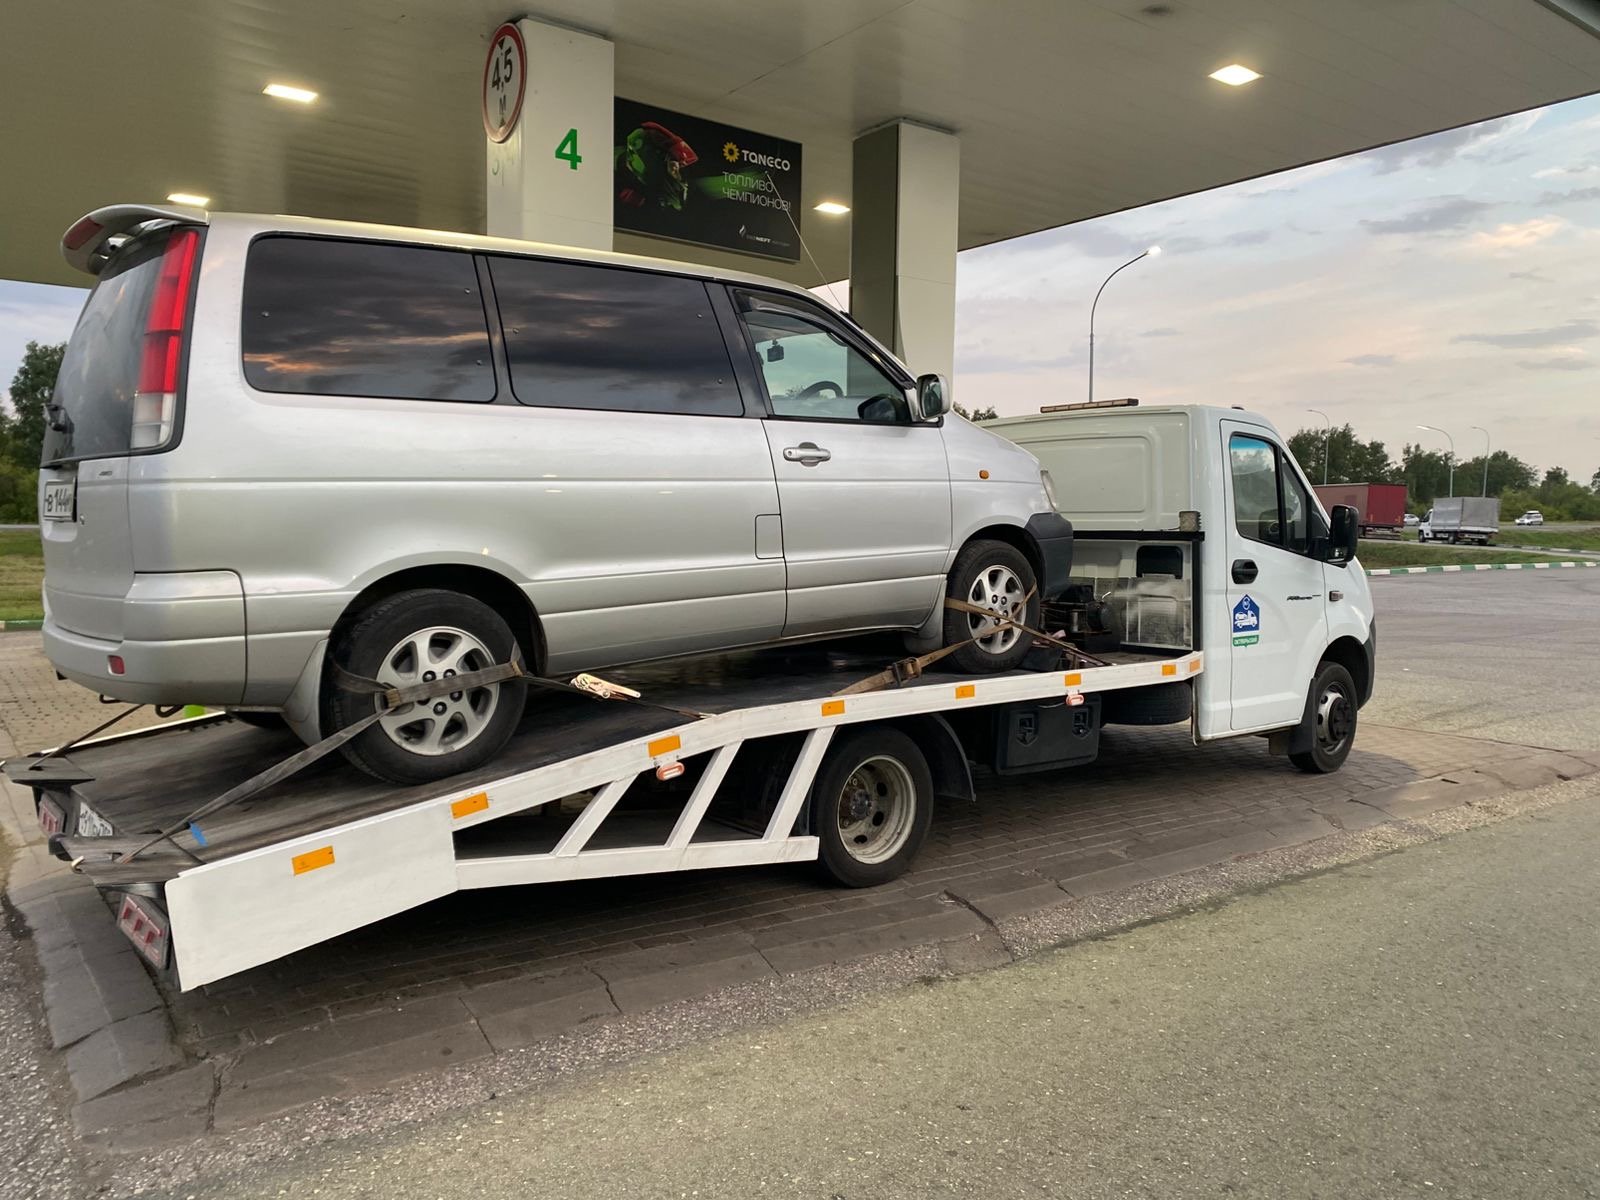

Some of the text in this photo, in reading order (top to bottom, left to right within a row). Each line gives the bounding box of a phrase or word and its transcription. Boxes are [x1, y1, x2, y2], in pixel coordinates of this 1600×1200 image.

[555, 128, 582, 171] 4
[741, 149, 791, 172] TANECO
[722, 171, 774, 193] ТОПЛИВО
[722, 187, 792, 212] ЧЕМПИОНОВ!
